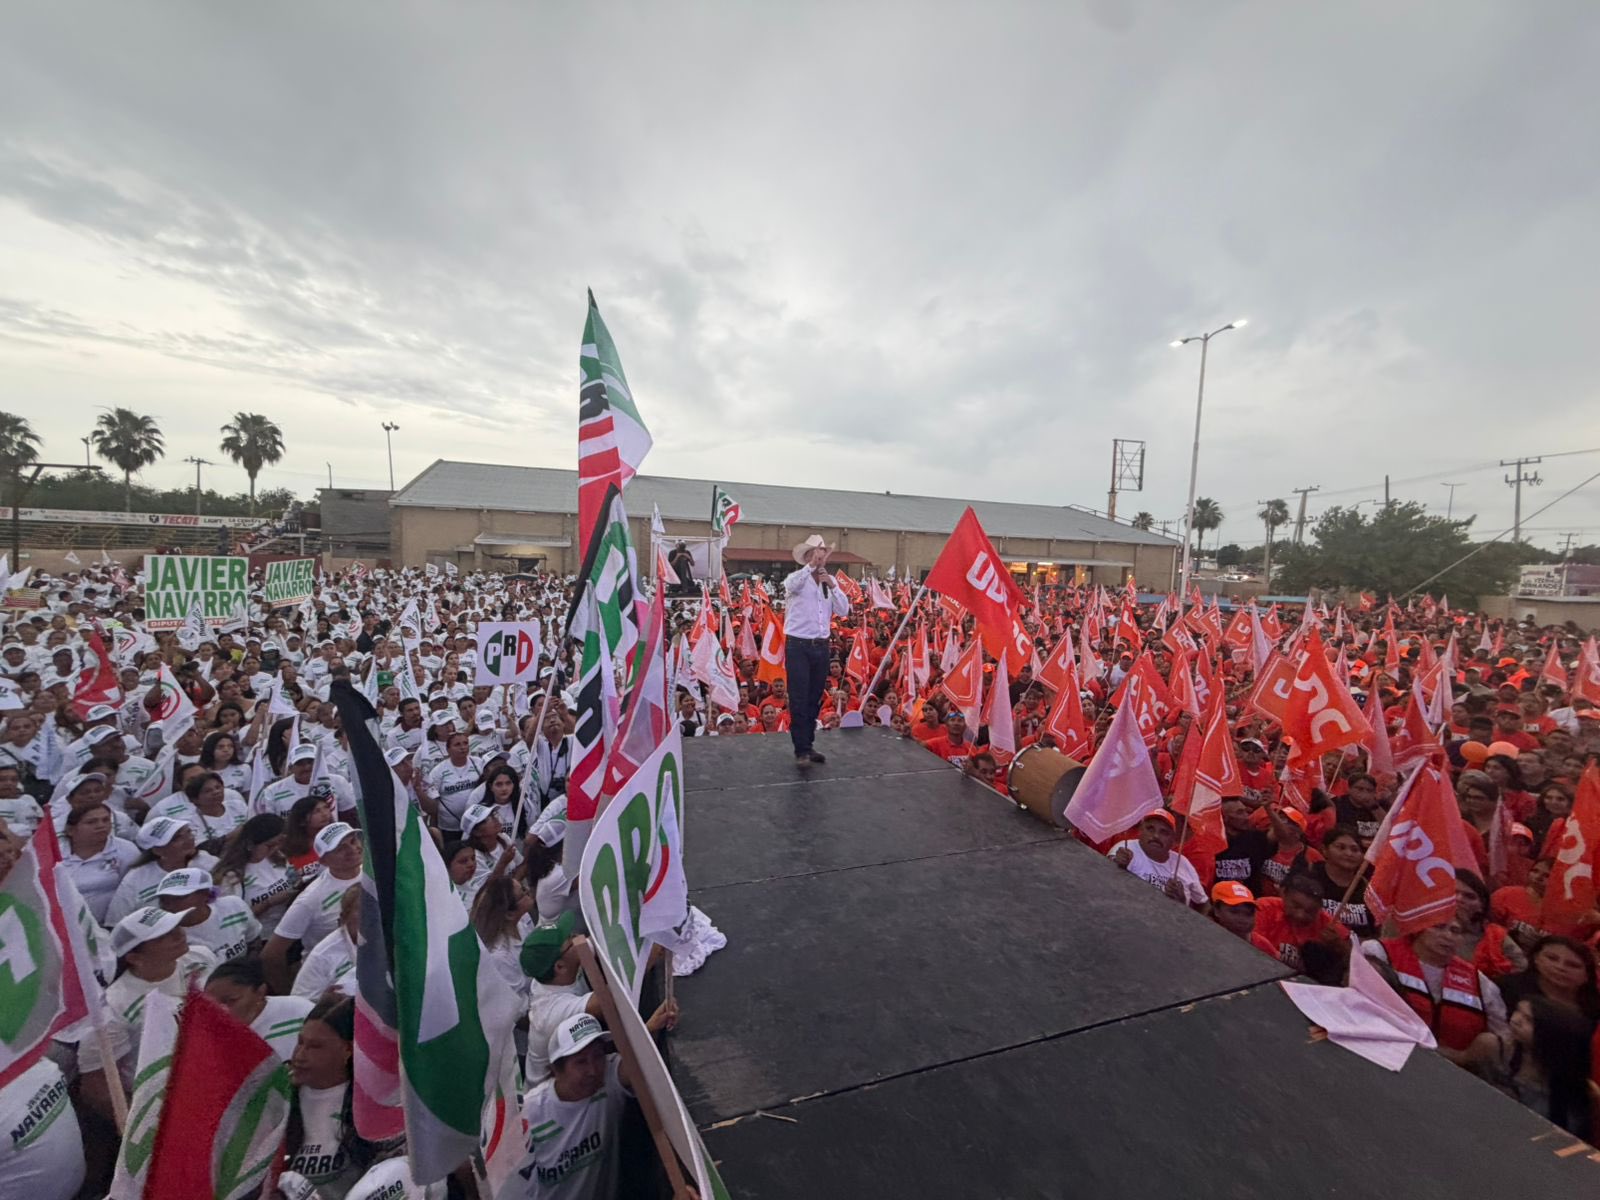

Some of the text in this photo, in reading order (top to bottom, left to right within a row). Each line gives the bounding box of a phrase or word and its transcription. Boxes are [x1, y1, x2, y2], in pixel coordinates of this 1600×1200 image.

[161, 515, 199, 525] TECATE
[146, 557, 247, 592] JAVIER
[266, 560, 313, 584] JAVIER
[266, 580, 313, 602] NAVARRO
[486, 635, 529, 665] PRI
[292, 1154, 345, 1175] ARRO
